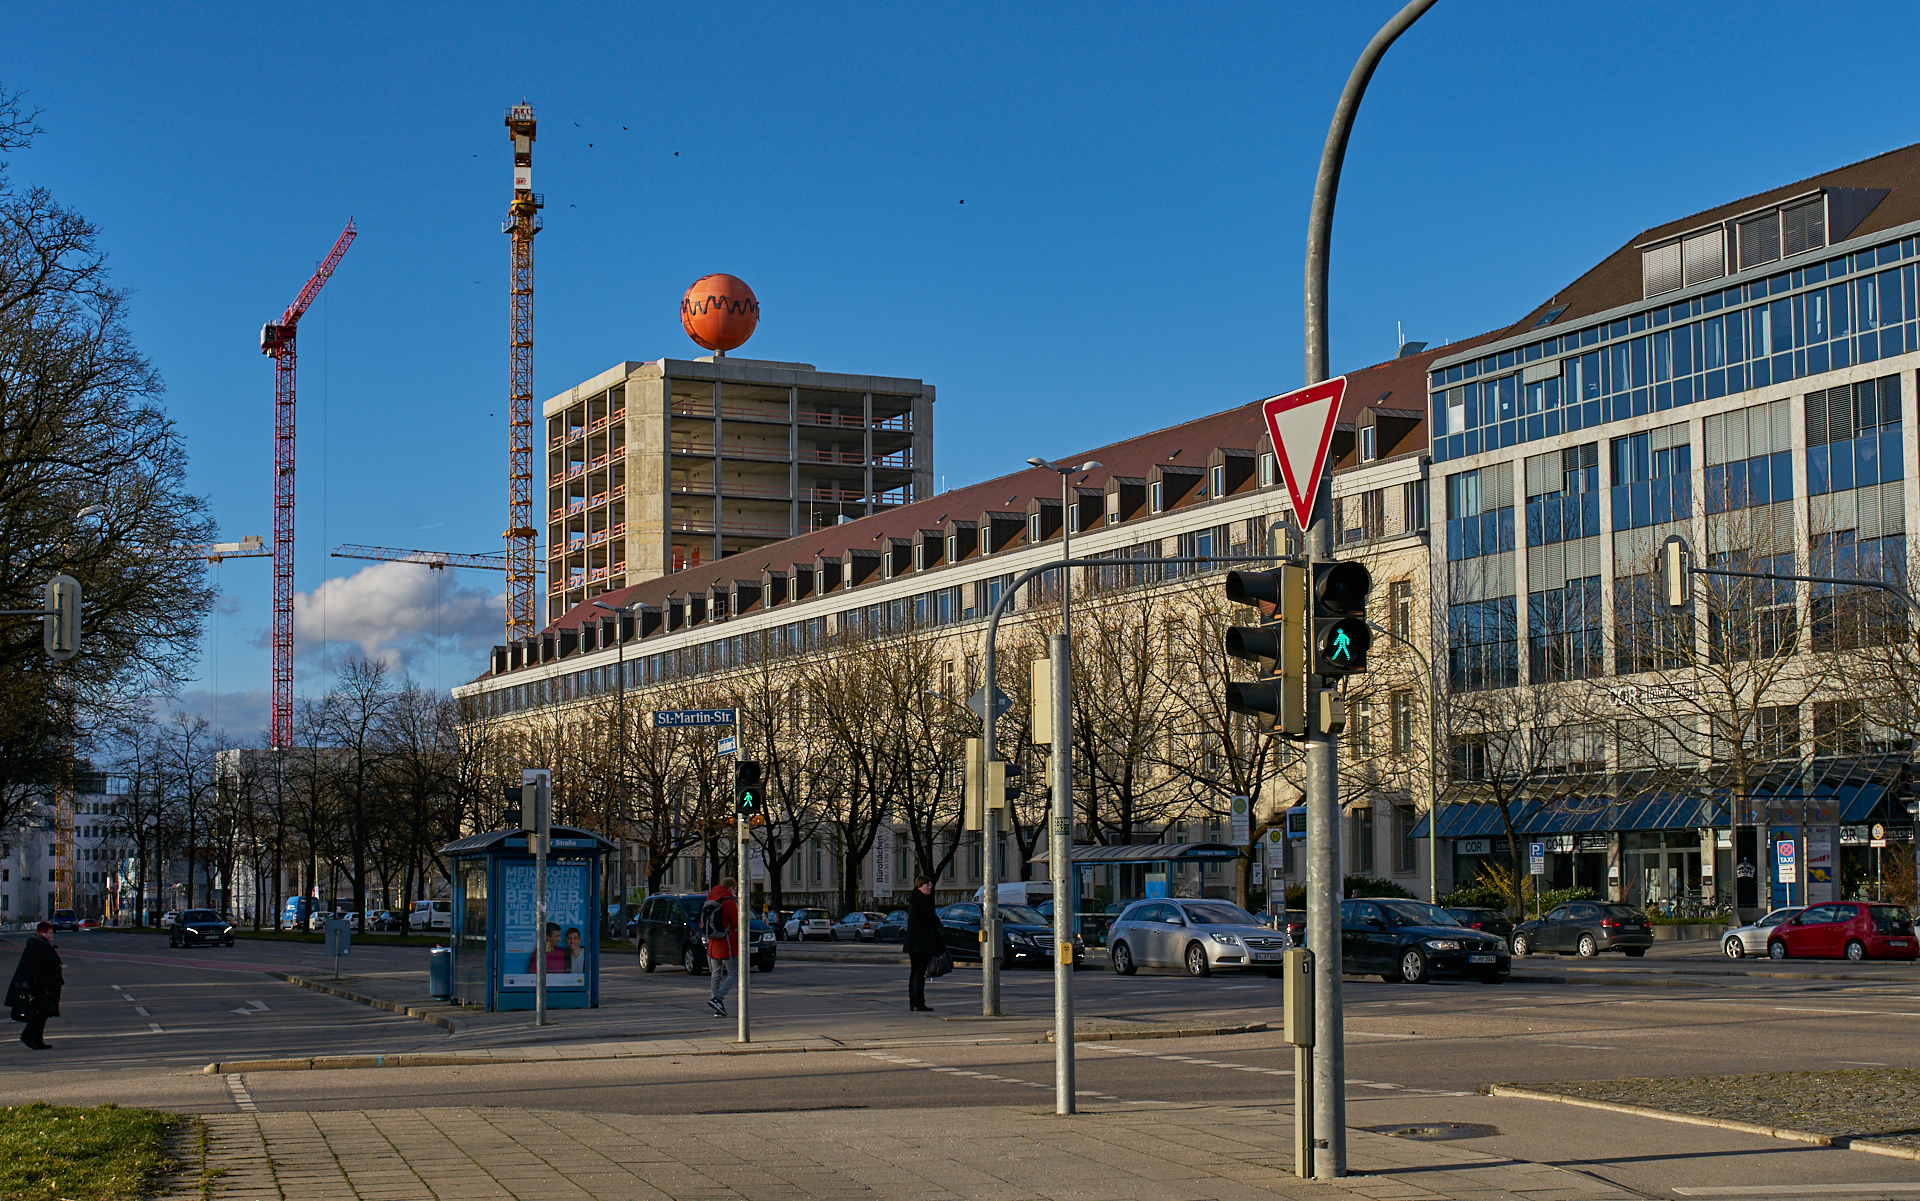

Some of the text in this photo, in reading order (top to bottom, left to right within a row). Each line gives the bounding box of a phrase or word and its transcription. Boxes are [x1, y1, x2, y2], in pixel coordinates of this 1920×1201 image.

[658, 711, 733, 724] St.-Martin-Str.
[1840, 829, 1855, 840] OR
[1465, 841, 1482, 852] COR
[1546, 839, 1563, 850] COR
[1532, 845, 1540, 856] P
